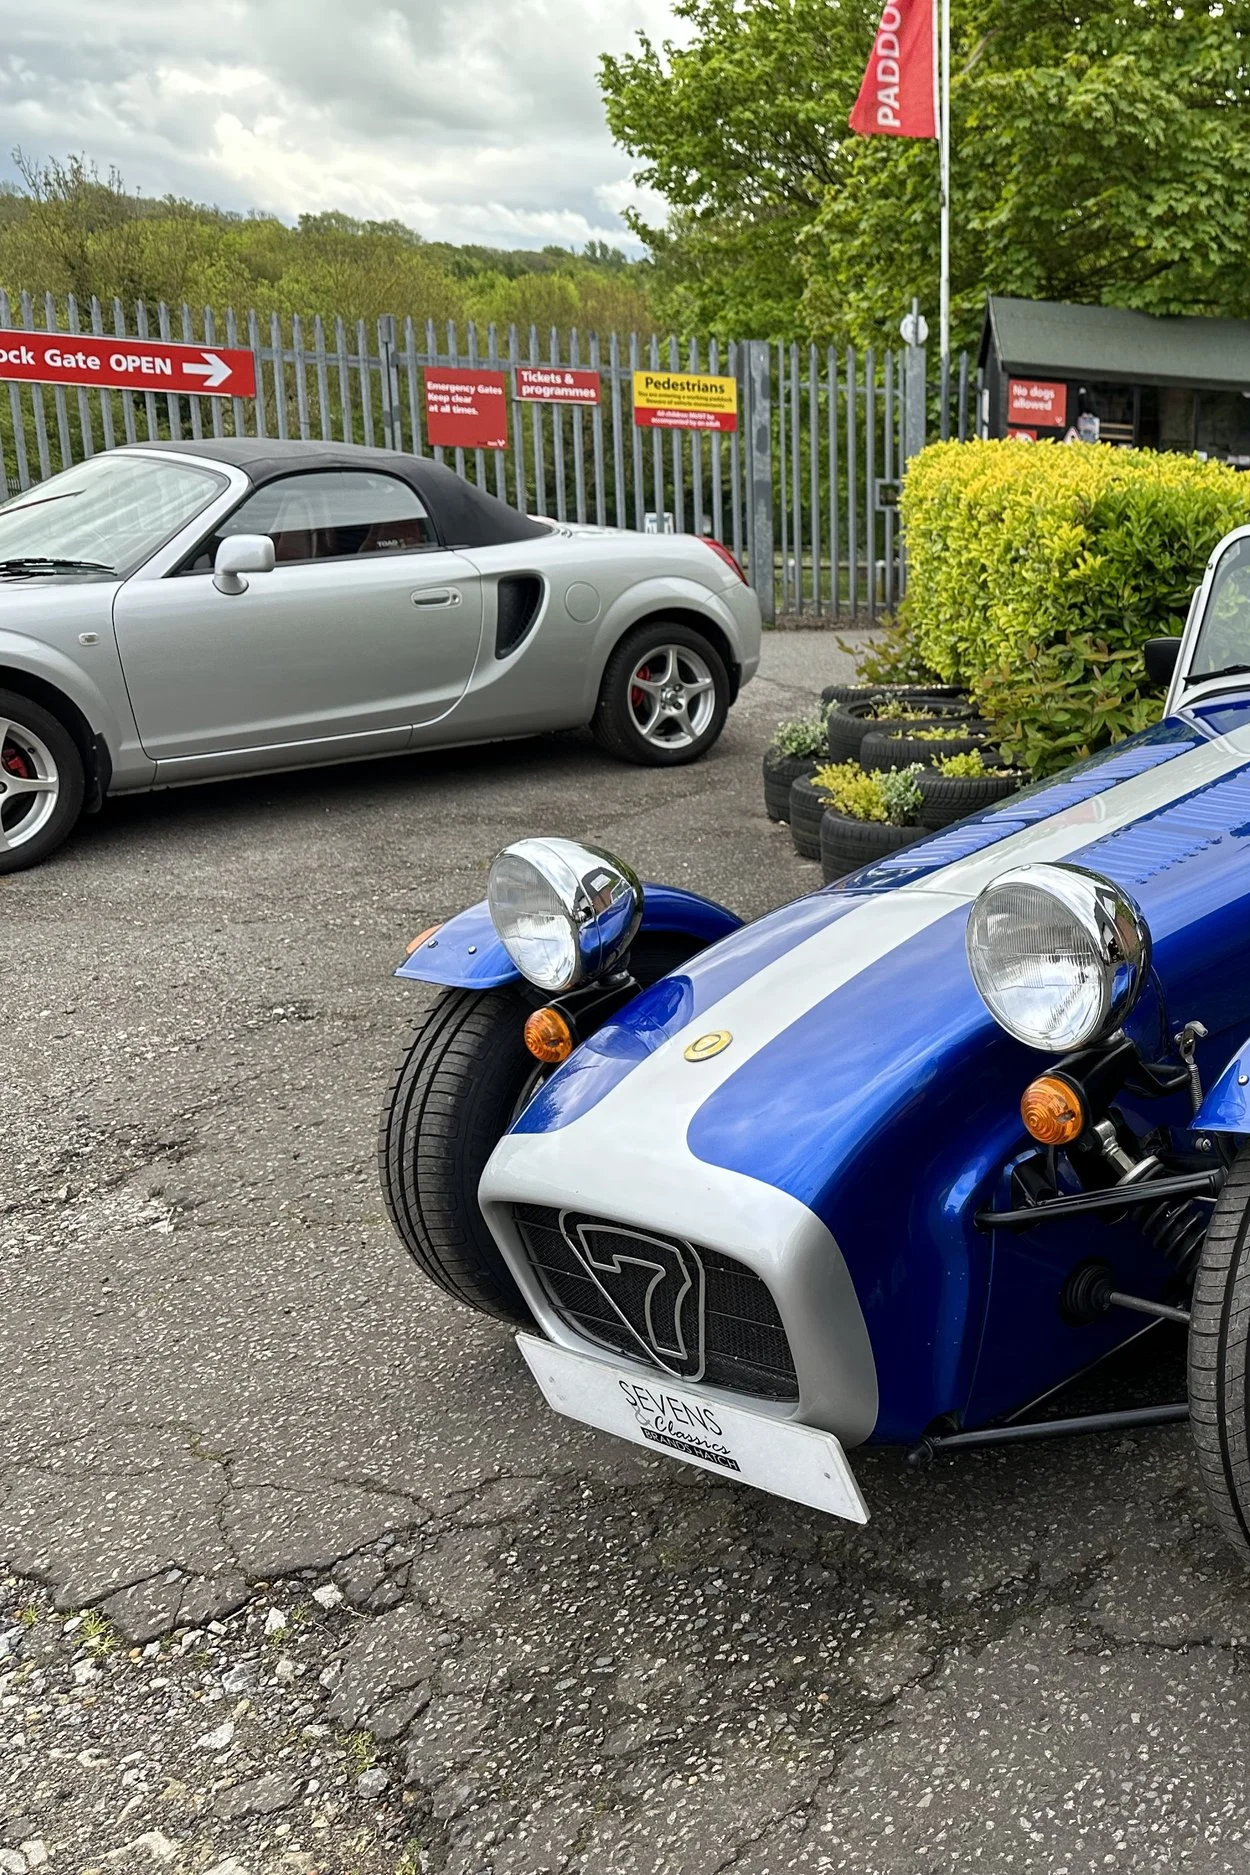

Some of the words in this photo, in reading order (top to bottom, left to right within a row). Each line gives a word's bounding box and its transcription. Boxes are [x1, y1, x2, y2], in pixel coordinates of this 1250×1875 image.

[876, 0, 901, 127] PADDO
[44, 349, 101, 370] Gate
[109, 353, 172, 375] OPEN
[521, 370, 562, 384] Tickets
[564, 373, 574, 385] &
[645, 376, 725, 394] Pedestrians
[427, 381, 476, 395] Emergency
[477, 384, 503, 395] Gates
[521, 385, 596, 398] programmes
[1012, 384, 1028, 397] No
[1029, 385, 1055, 400] dogs
[427, 392, 450, 403] Keep
[451, 394, 473, 403] clear
[1012, 397, 1053, 411] allowed
[428, 404, 439, 413] at
[440, 404, 451, 413] all
[576, 1223, 692, 1361] 7
[618, 1380, 723, 1436] SEVENS
[654, 1415, 731, 1454] Classics
[642, 1428, 694, 1455] BRANDS
[693, 1447, 740, 1471] HATCH
